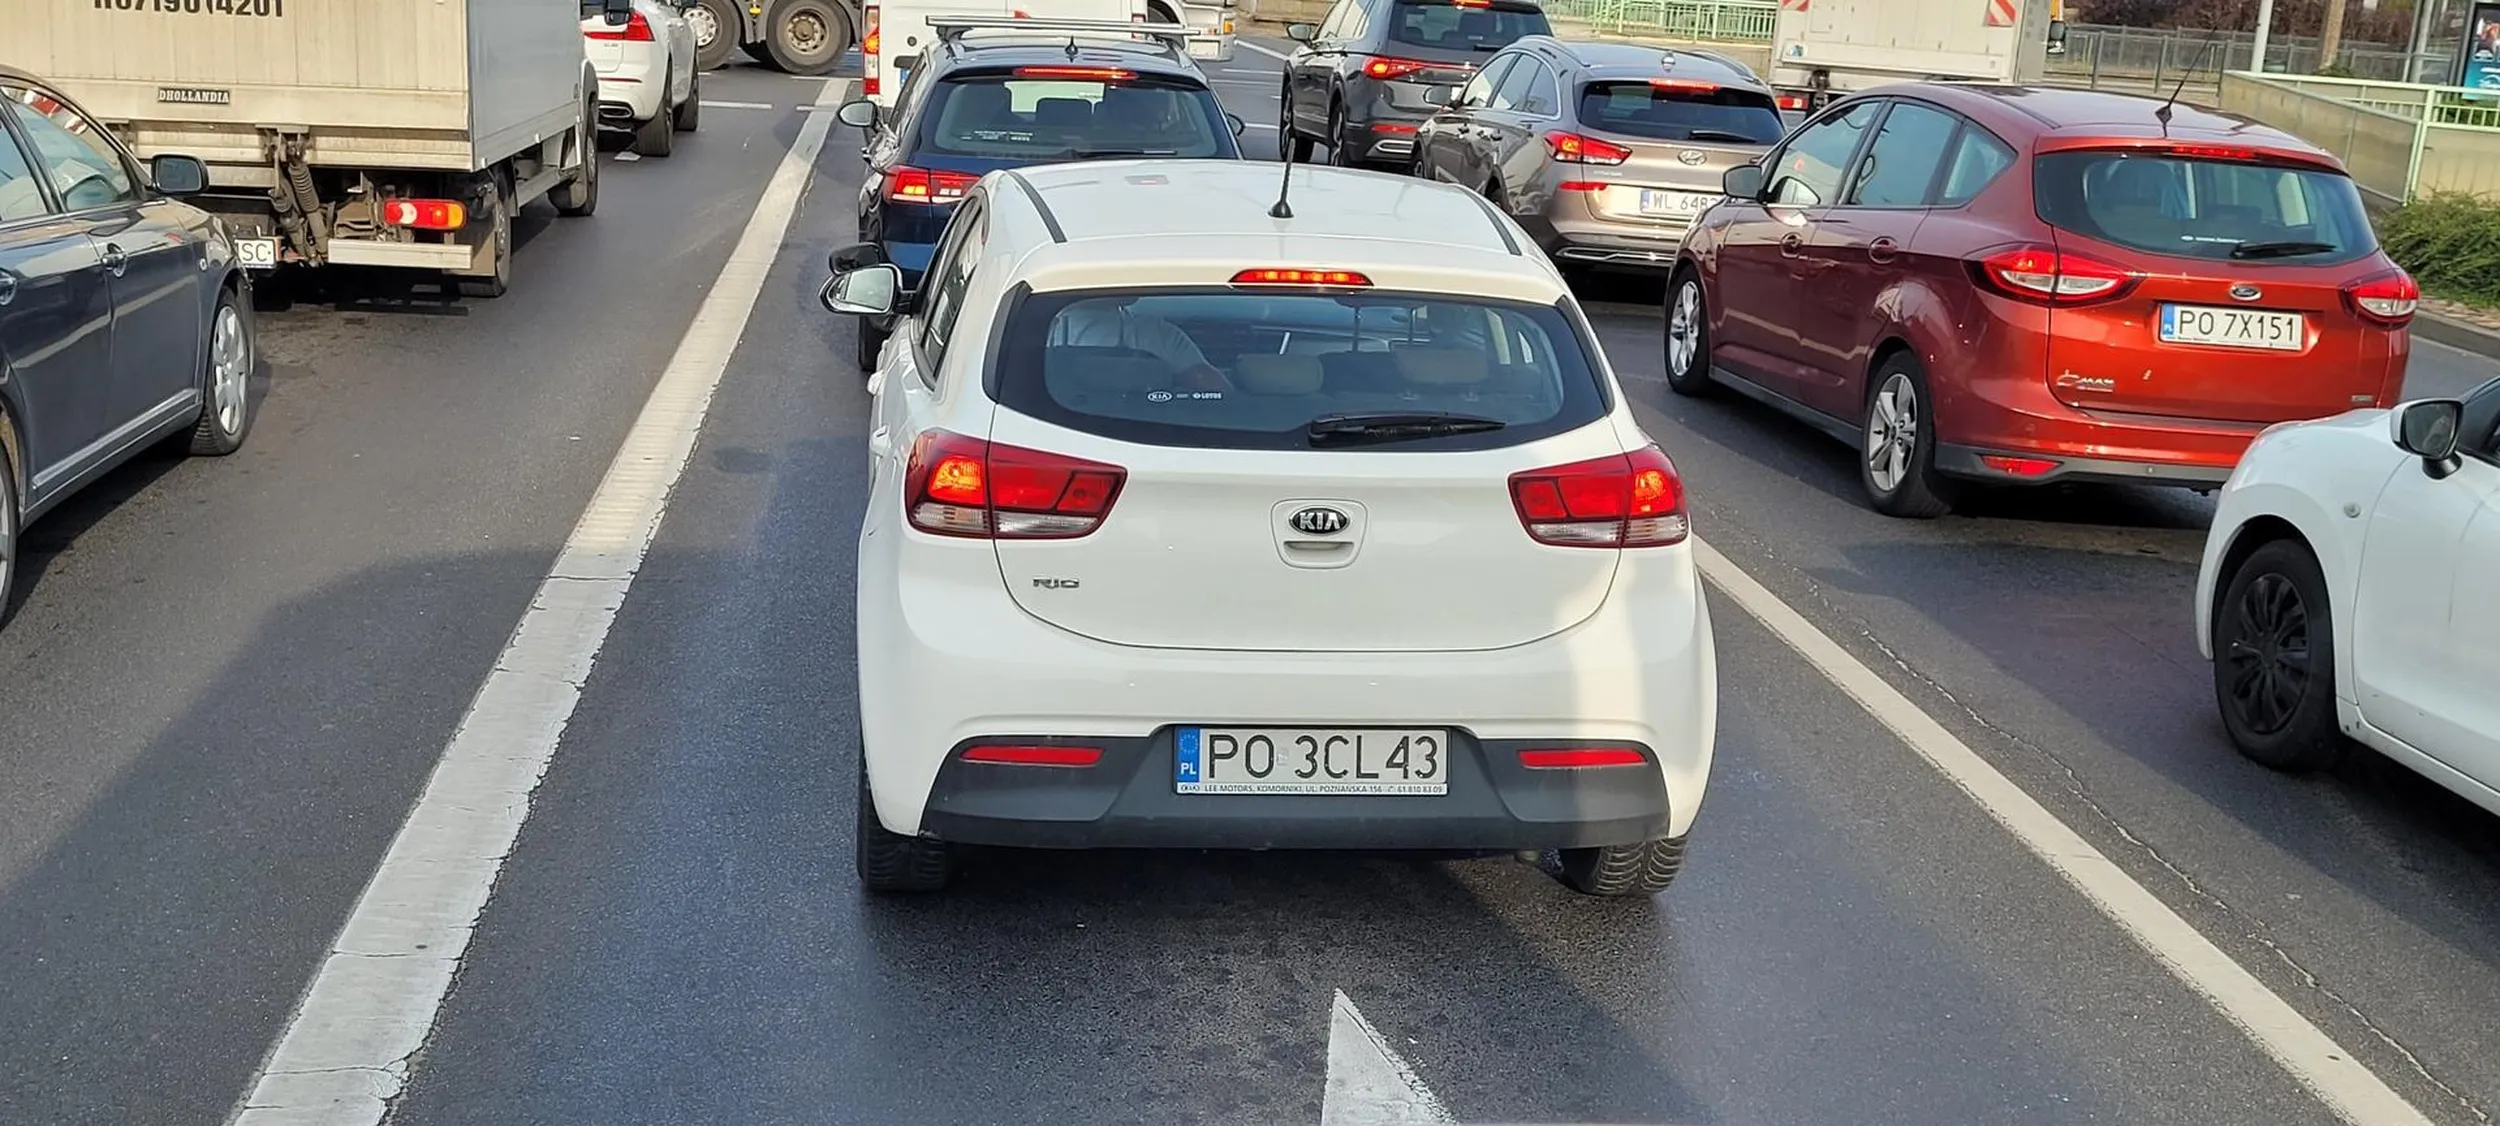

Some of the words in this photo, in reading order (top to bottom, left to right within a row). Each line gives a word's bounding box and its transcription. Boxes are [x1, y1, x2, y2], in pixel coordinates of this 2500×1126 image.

[158, 88, 230, 104] DHOLLANDIA
[1653, 193, 1673, 210] WL
[1680, 195, 1719, 211] 648
[241, 242, 268, 262] SC
[2179, 310, 2215, 336] PO
[2223, 312, 2294, 342] 7X151
[1300, 511, 1341, 530] KIA
[1032, 578, 1080, 589] RIO
[1208, 733, 1275, 779] PO
[1293, 734, 1439, 780] 3CL43
[1180, 761, 1197, 776] PL
[1204, 784, 1218, 792] LEE
